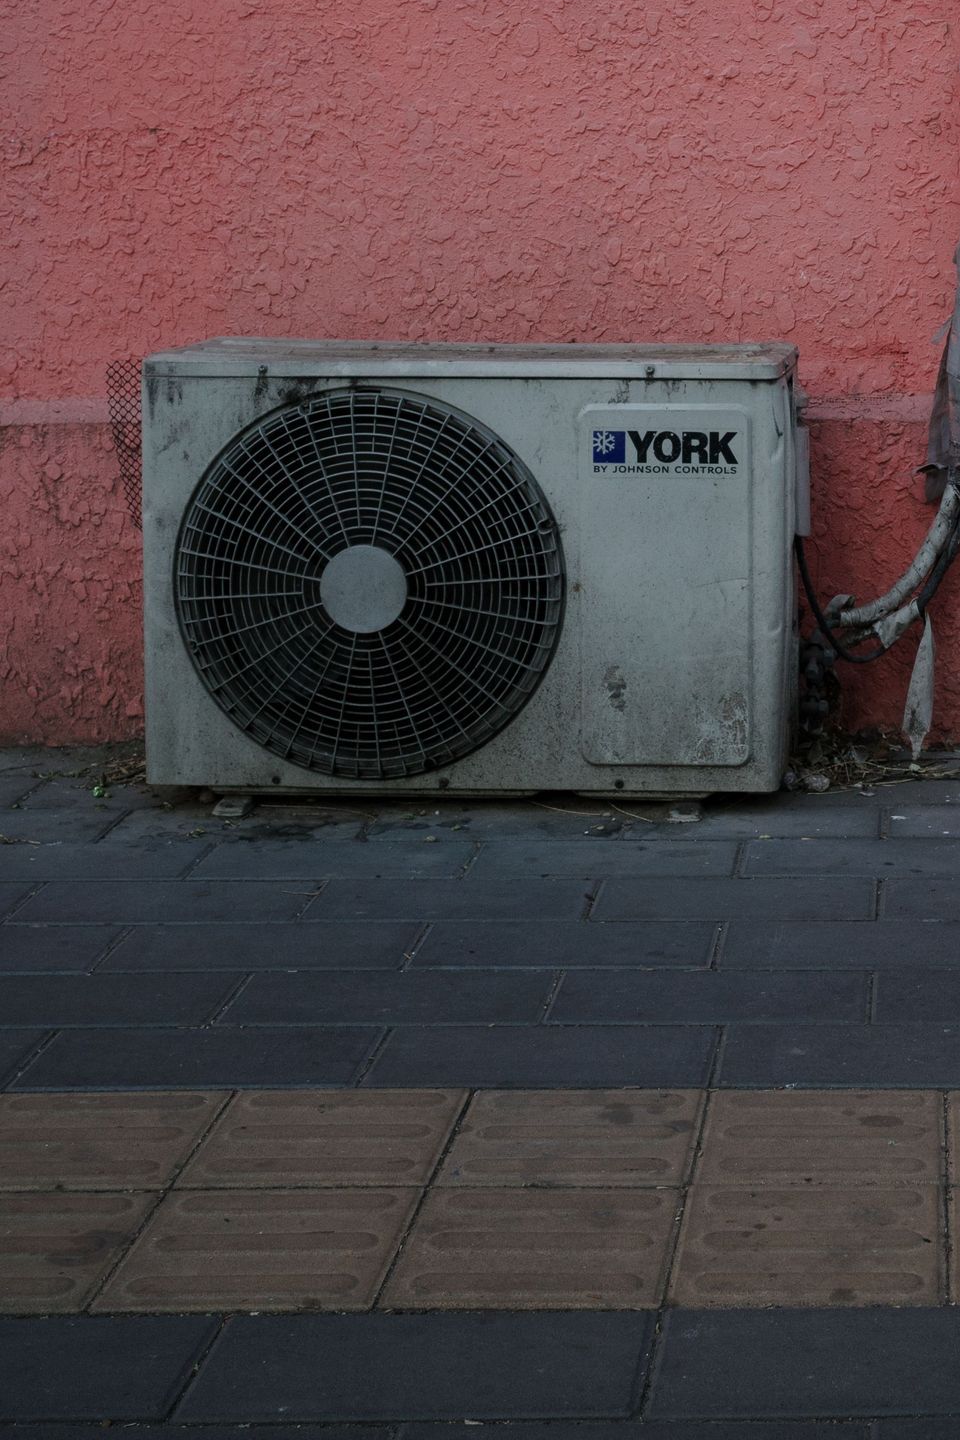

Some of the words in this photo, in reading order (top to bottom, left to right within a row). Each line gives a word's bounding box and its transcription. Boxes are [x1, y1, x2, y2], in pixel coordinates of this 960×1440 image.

[627, 430, 739, 465] YORK
[593, 465, 608, 474] BY
[612, 465, 669, 474] JOHNSON
[674, 466, 737, 475] CONTROLS
